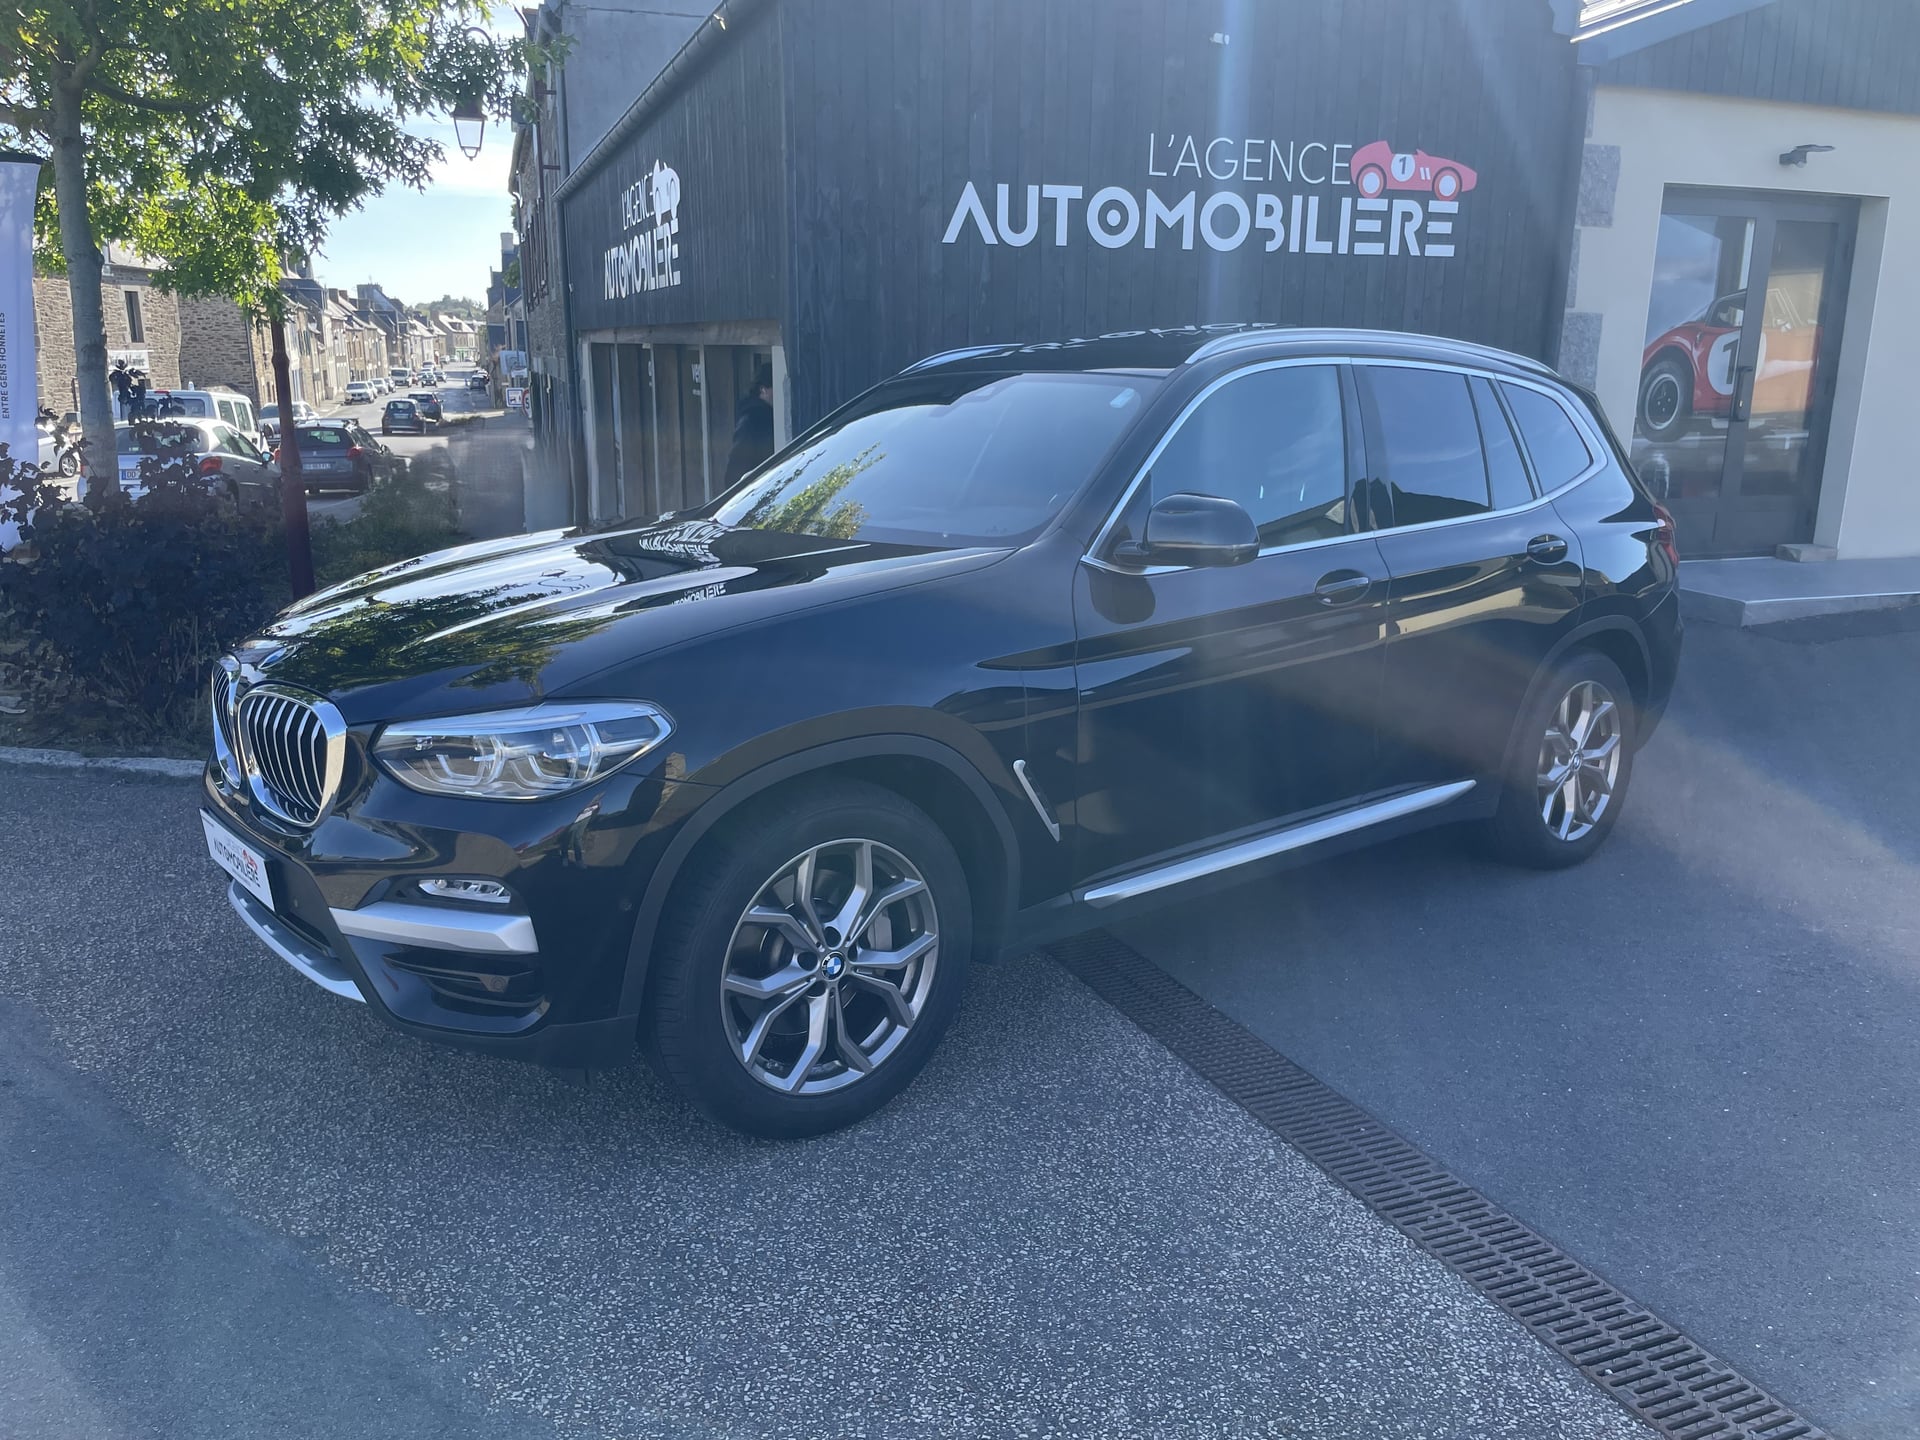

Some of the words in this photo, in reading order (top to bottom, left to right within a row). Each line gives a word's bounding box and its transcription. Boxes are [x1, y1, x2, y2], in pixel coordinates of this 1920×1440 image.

[1148, 132, 1353, 185] L'AGENCE
[1398, 156, 1408, 175] 1
[941, 181, 1460, 257] AUTOMOBILIERE
[0, 362, 8, 389] GENS
[1722, 338, 1739, 385] 1
[0, 389, 10, 419] ENTRE
